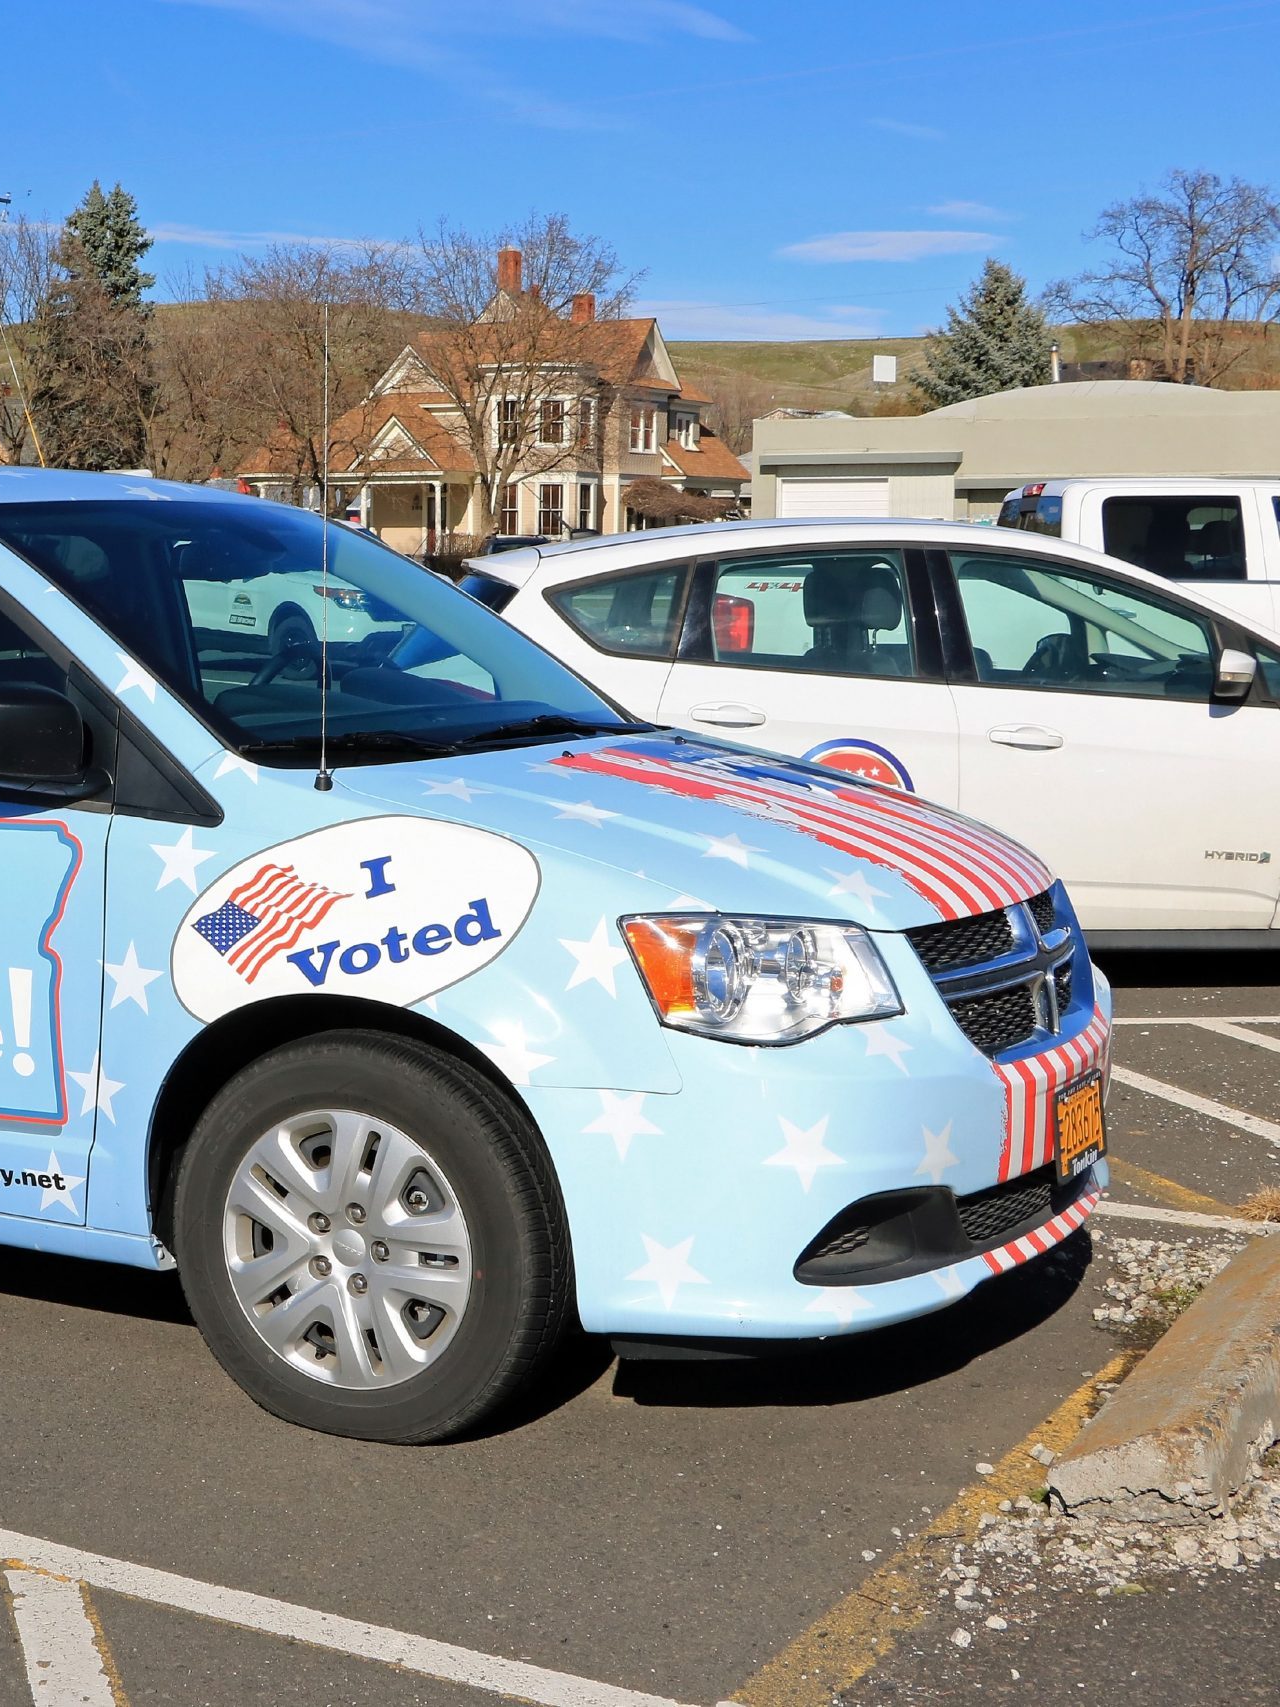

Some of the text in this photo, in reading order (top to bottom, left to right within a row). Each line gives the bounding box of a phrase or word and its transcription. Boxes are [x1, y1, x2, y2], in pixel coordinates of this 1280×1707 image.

[359, 856, 396, 900] I
[1204, 850, 1259, 862] HYBRID
[287, 898, 502, 987] Voted
[1059, 1091, 1100, 1153] 283675
[1072, 1148, 1097, 1176] Tonkin
